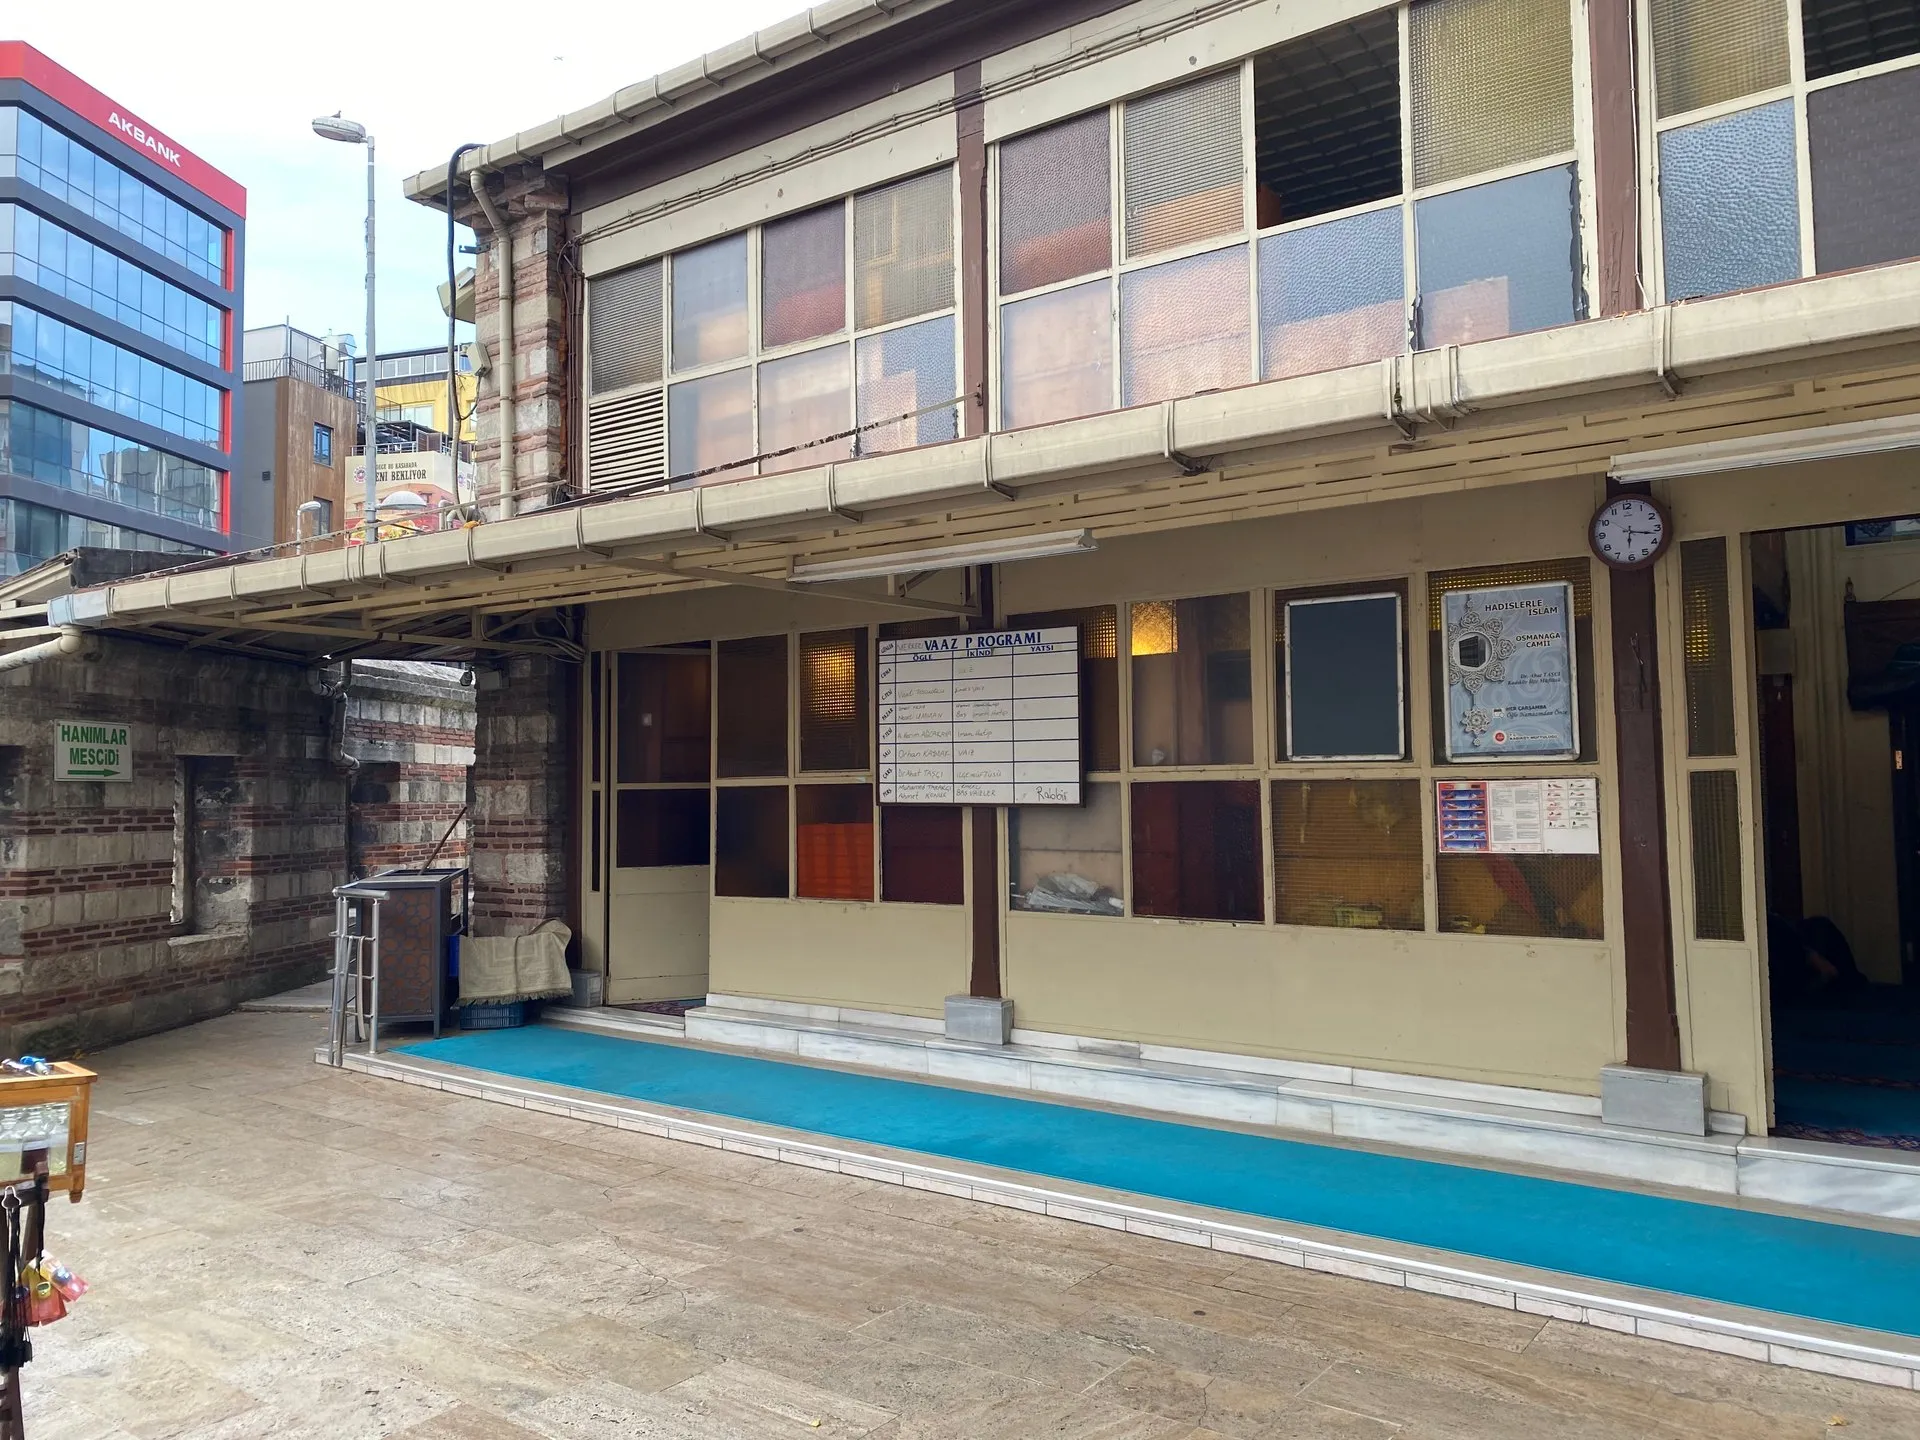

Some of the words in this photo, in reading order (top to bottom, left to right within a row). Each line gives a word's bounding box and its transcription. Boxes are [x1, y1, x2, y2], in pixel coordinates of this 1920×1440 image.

[108, 112, 181, 167] AKBANK
[376, 471, 388, 482] ENI
[1648, 512, 1656, 520] 2
[1601, 519, 1610, 527] 10
[1654, 524, 1662, 532] 3
[1598, 532, 1606, 540] 9
[1650, 537, 1658, 545] 4
[1603, 543, 1612, 552] 8
[1614, 552, 1621, 560] 7
[1641, 548, 1649, 556] 5
[1627, 553, 1636, 562] 6
[924, 637, 959, 651] VAAZ
[61, 725, 127, 745] HANIMLAR
